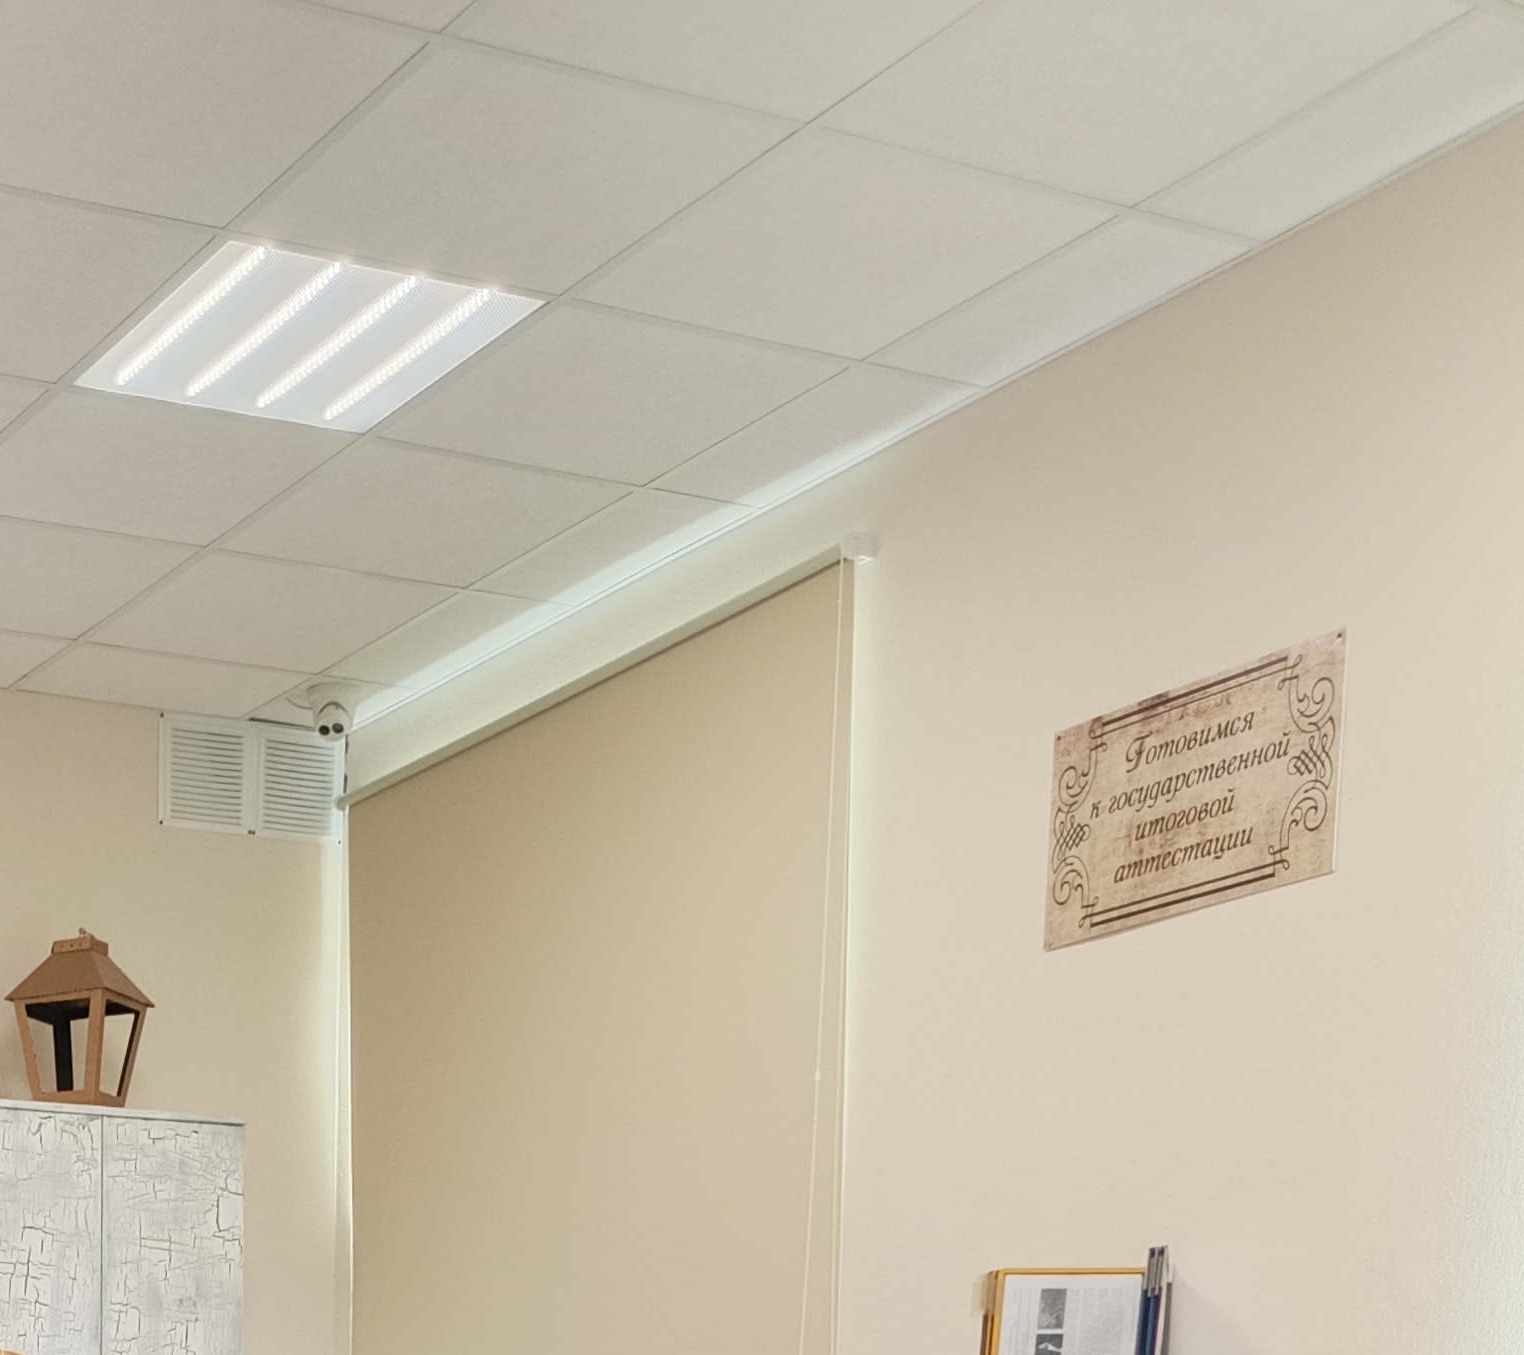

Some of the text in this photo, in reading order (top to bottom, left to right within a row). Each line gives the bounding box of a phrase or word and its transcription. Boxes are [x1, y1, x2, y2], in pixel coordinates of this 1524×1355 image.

[1126, 710, 1255, 773] Готовимся
[1089, 730, 1292, 820] к государственной
[1134, 787, 1236, 841] итоговой
[1114, 826, 1254, 884] аттестации
